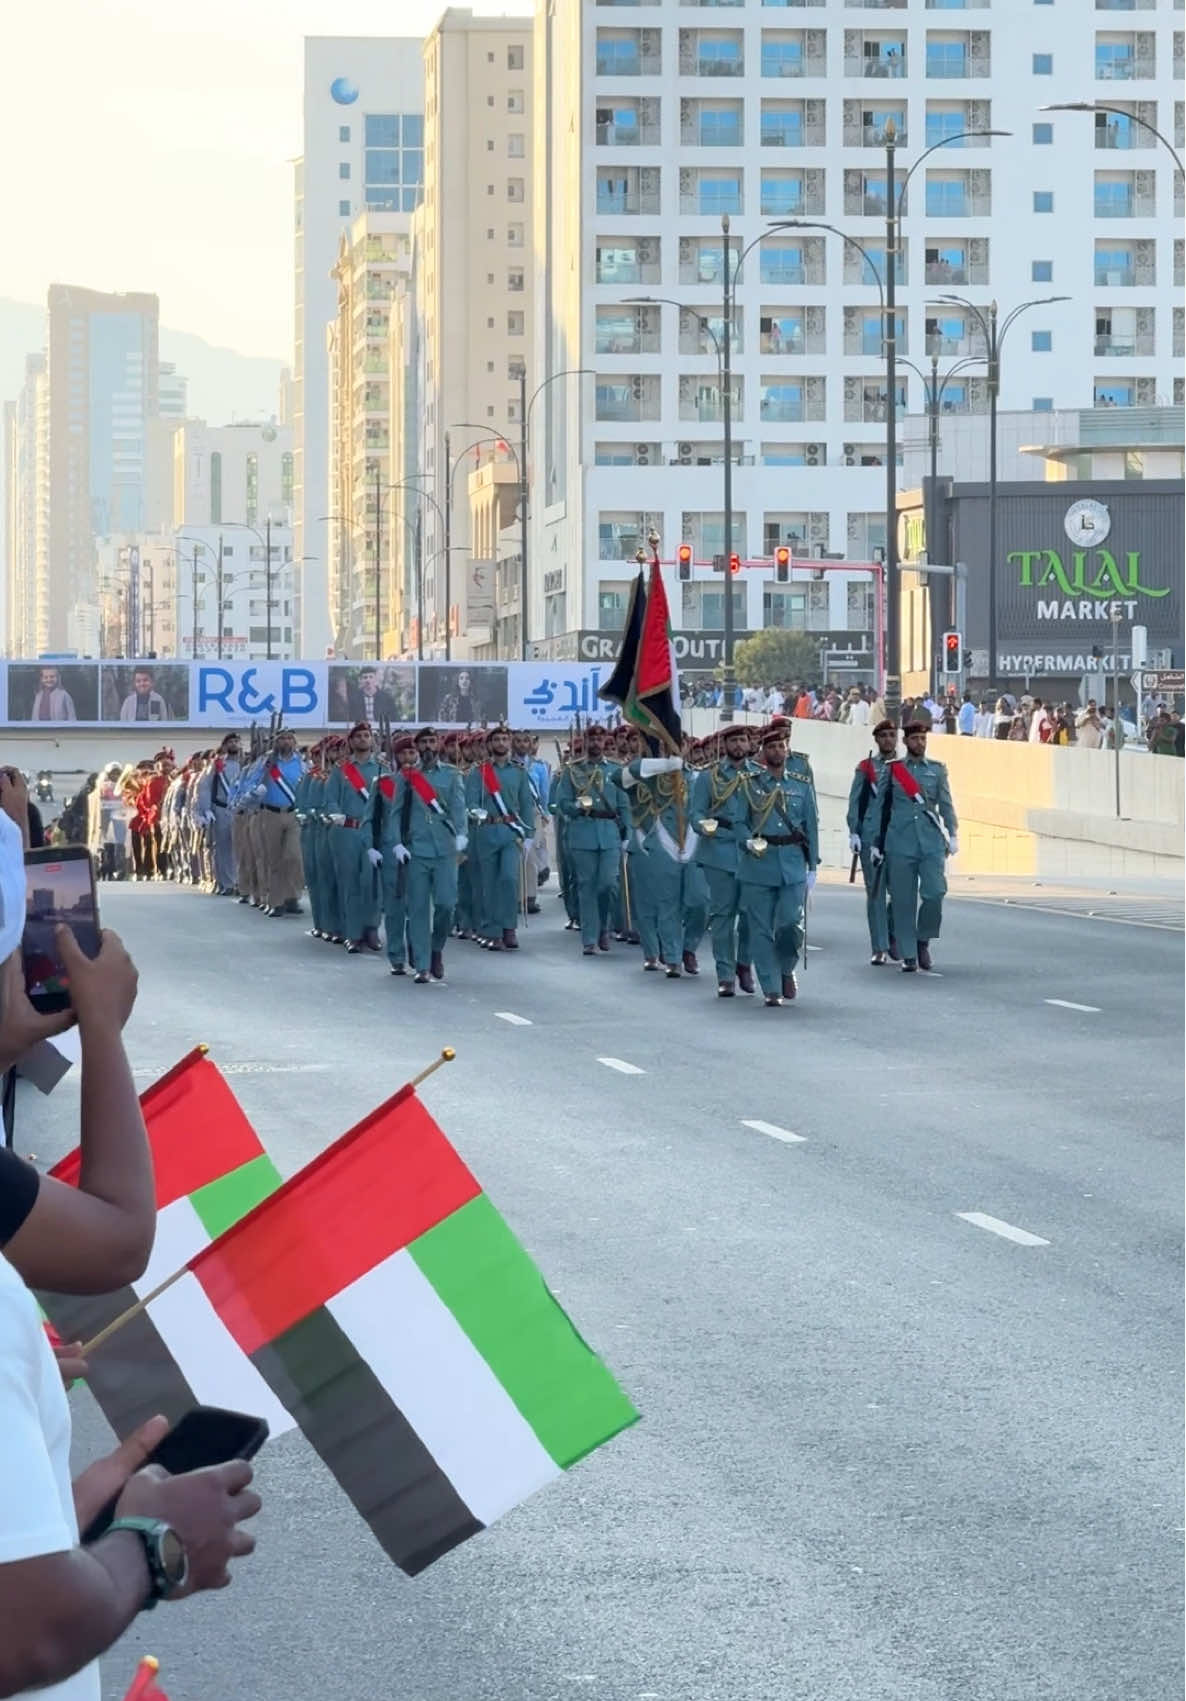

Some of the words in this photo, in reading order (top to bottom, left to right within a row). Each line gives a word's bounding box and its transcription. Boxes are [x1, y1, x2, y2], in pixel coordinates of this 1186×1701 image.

[1007, 549, 1171, 598] TALAL
[1037, 600, 1138, 620] MARKET
[198, 667, 318, 714] R&B
